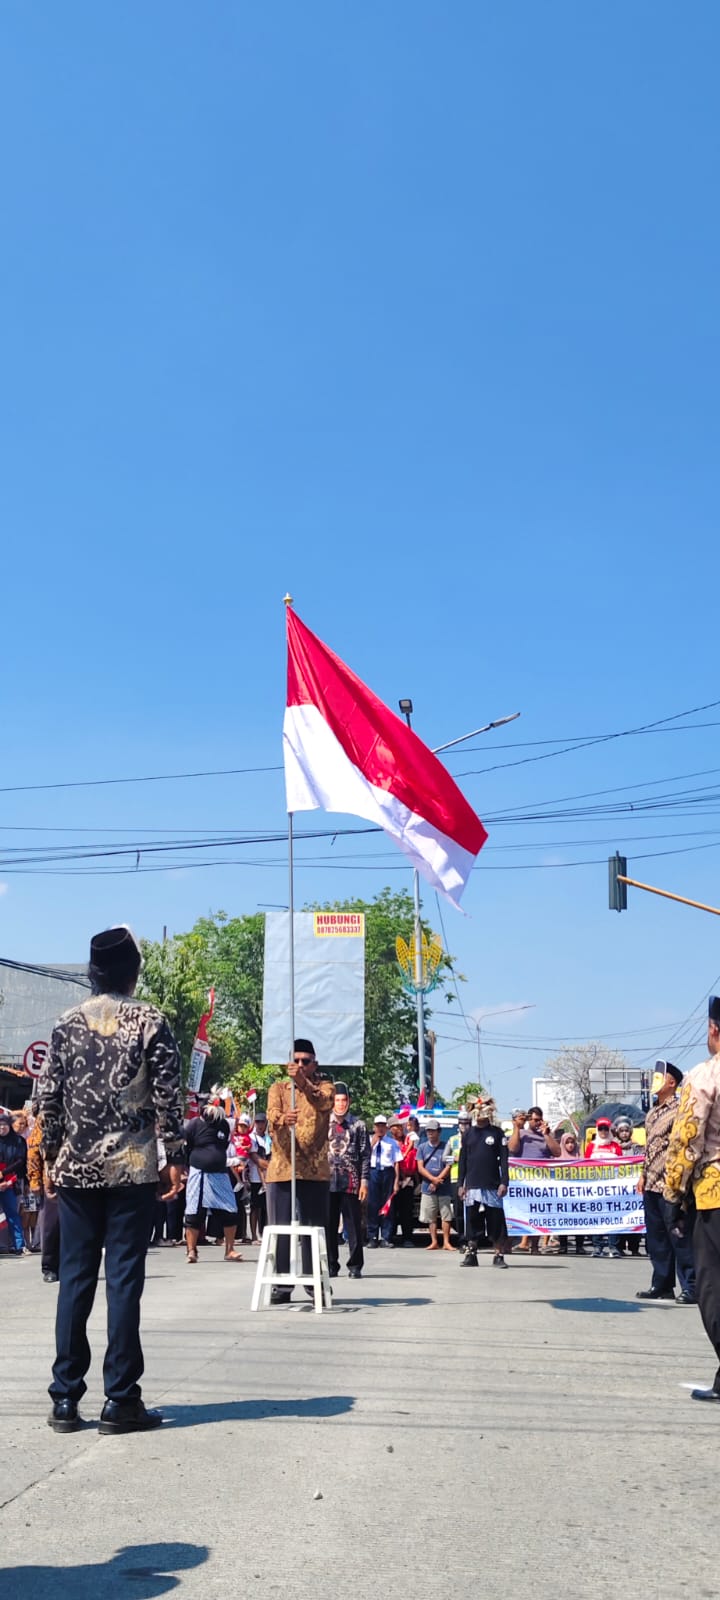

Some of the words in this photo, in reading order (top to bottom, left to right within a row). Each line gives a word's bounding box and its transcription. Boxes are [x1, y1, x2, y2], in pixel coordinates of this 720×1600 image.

[317, 915, 360, 924] HUBUNGI
[508, 1167, 551, 1180] MOHON
[555, 1166, 614, 1180] BERHENTI
[618, 1164, 644, 1178] SEJE
[509, 1187, 558, 1197] ERINGATI
[562, 1185, 629, 1197] DETIK-DETIK
[530, 1203, 552, 1212] HUT
[557, 1203, 567, 1212] RI
[571, 1202, 602, 1212] KE-80
[606, 1201, 645, 1211] TH.202
[529, 1218, 556, 1226] POLRES
[559, 1217, 598, 1226] GROBOGAN
[601, 1217, 623, 1225] POLDA
